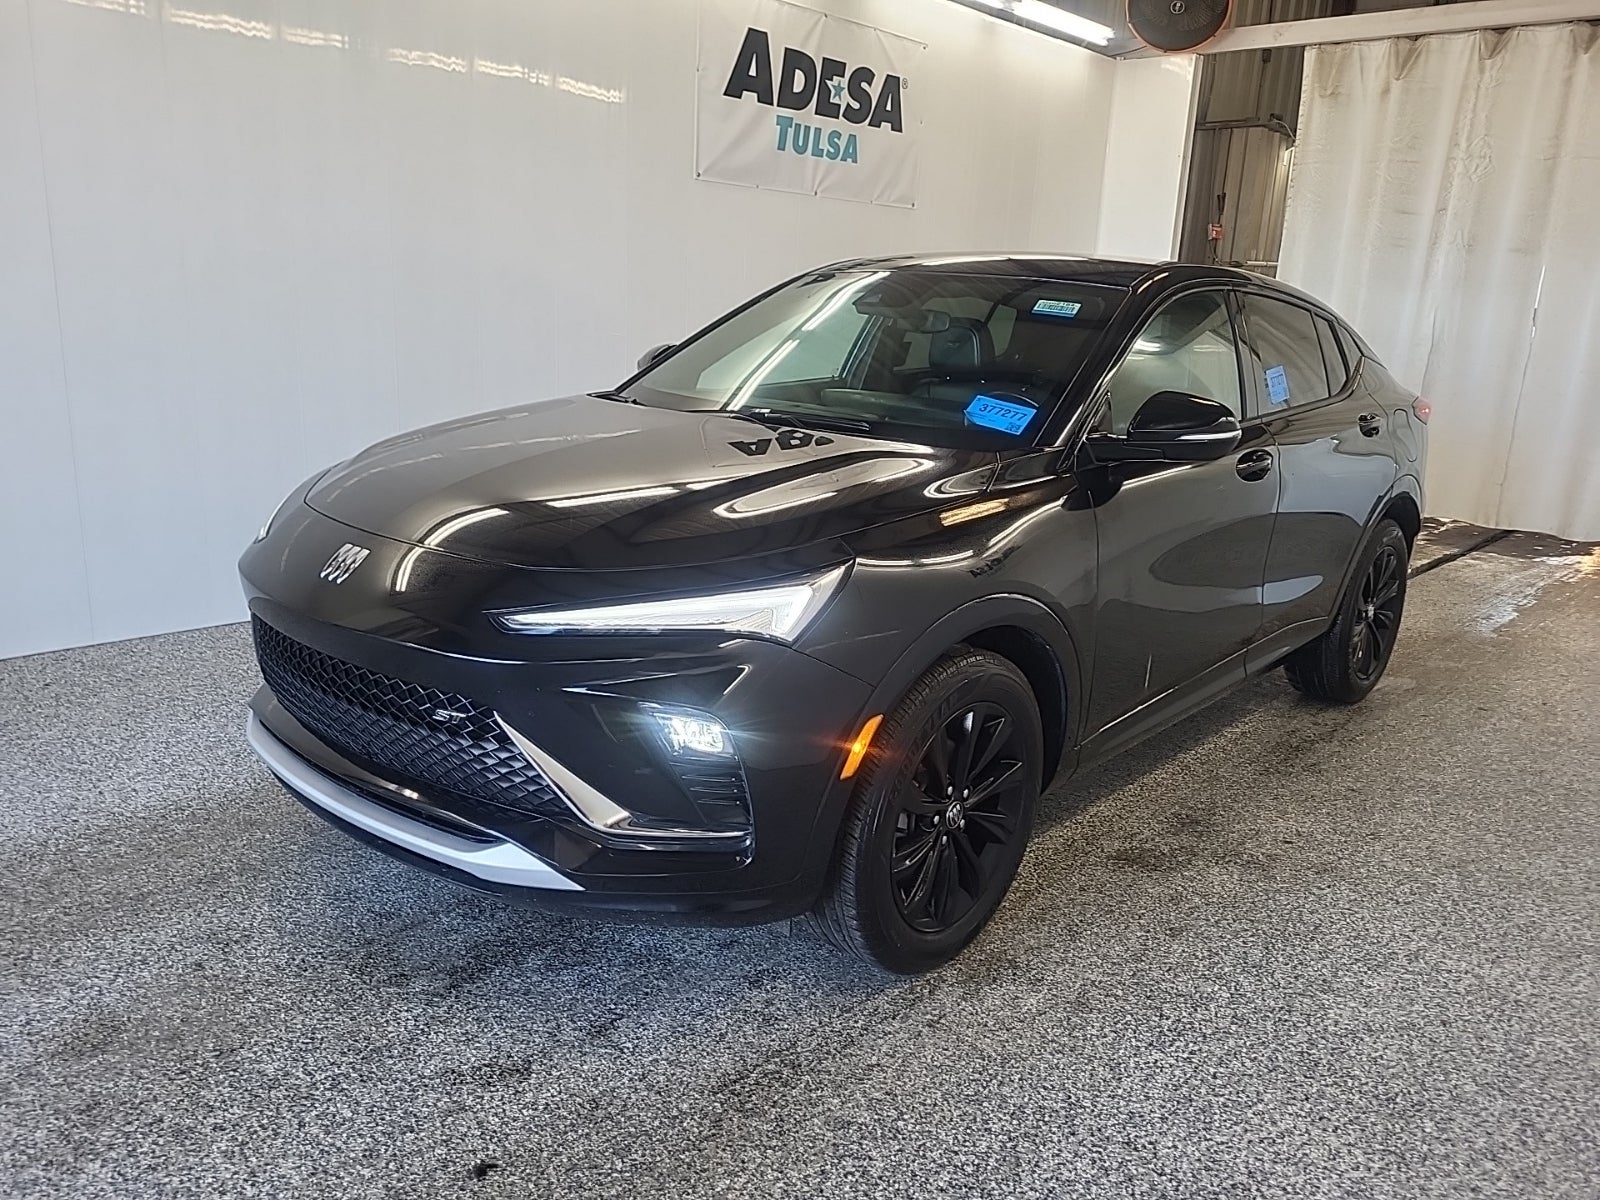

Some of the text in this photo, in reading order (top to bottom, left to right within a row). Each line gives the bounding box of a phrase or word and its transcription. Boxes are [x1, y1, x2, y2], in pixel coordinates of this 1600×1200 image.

[723, 27, 903, 133] ADESA
[776, 115, 858, 163] TULSA
[979, 403, 1028, 421] 377277
[432, 709, 466, 724] ST
